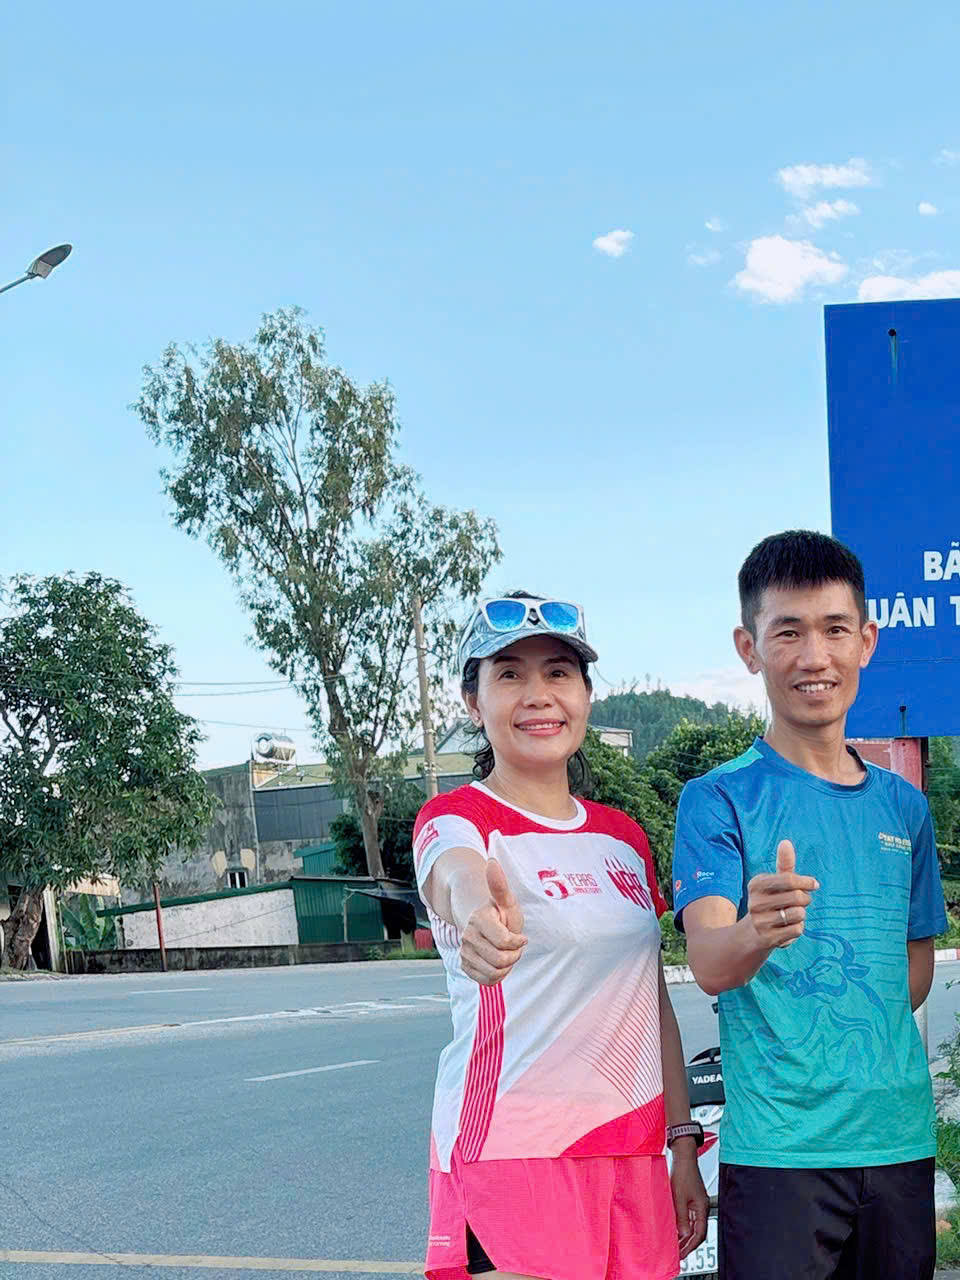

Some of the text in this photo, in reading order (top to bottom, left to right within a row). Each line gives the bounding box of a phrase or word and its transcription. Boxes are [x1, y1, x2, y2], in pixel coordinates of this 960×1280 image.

[866, 591, 935, 630] UÂN
[537, 868, 569, 900] 5
[691, 1073, 723, 1085] YADEA
